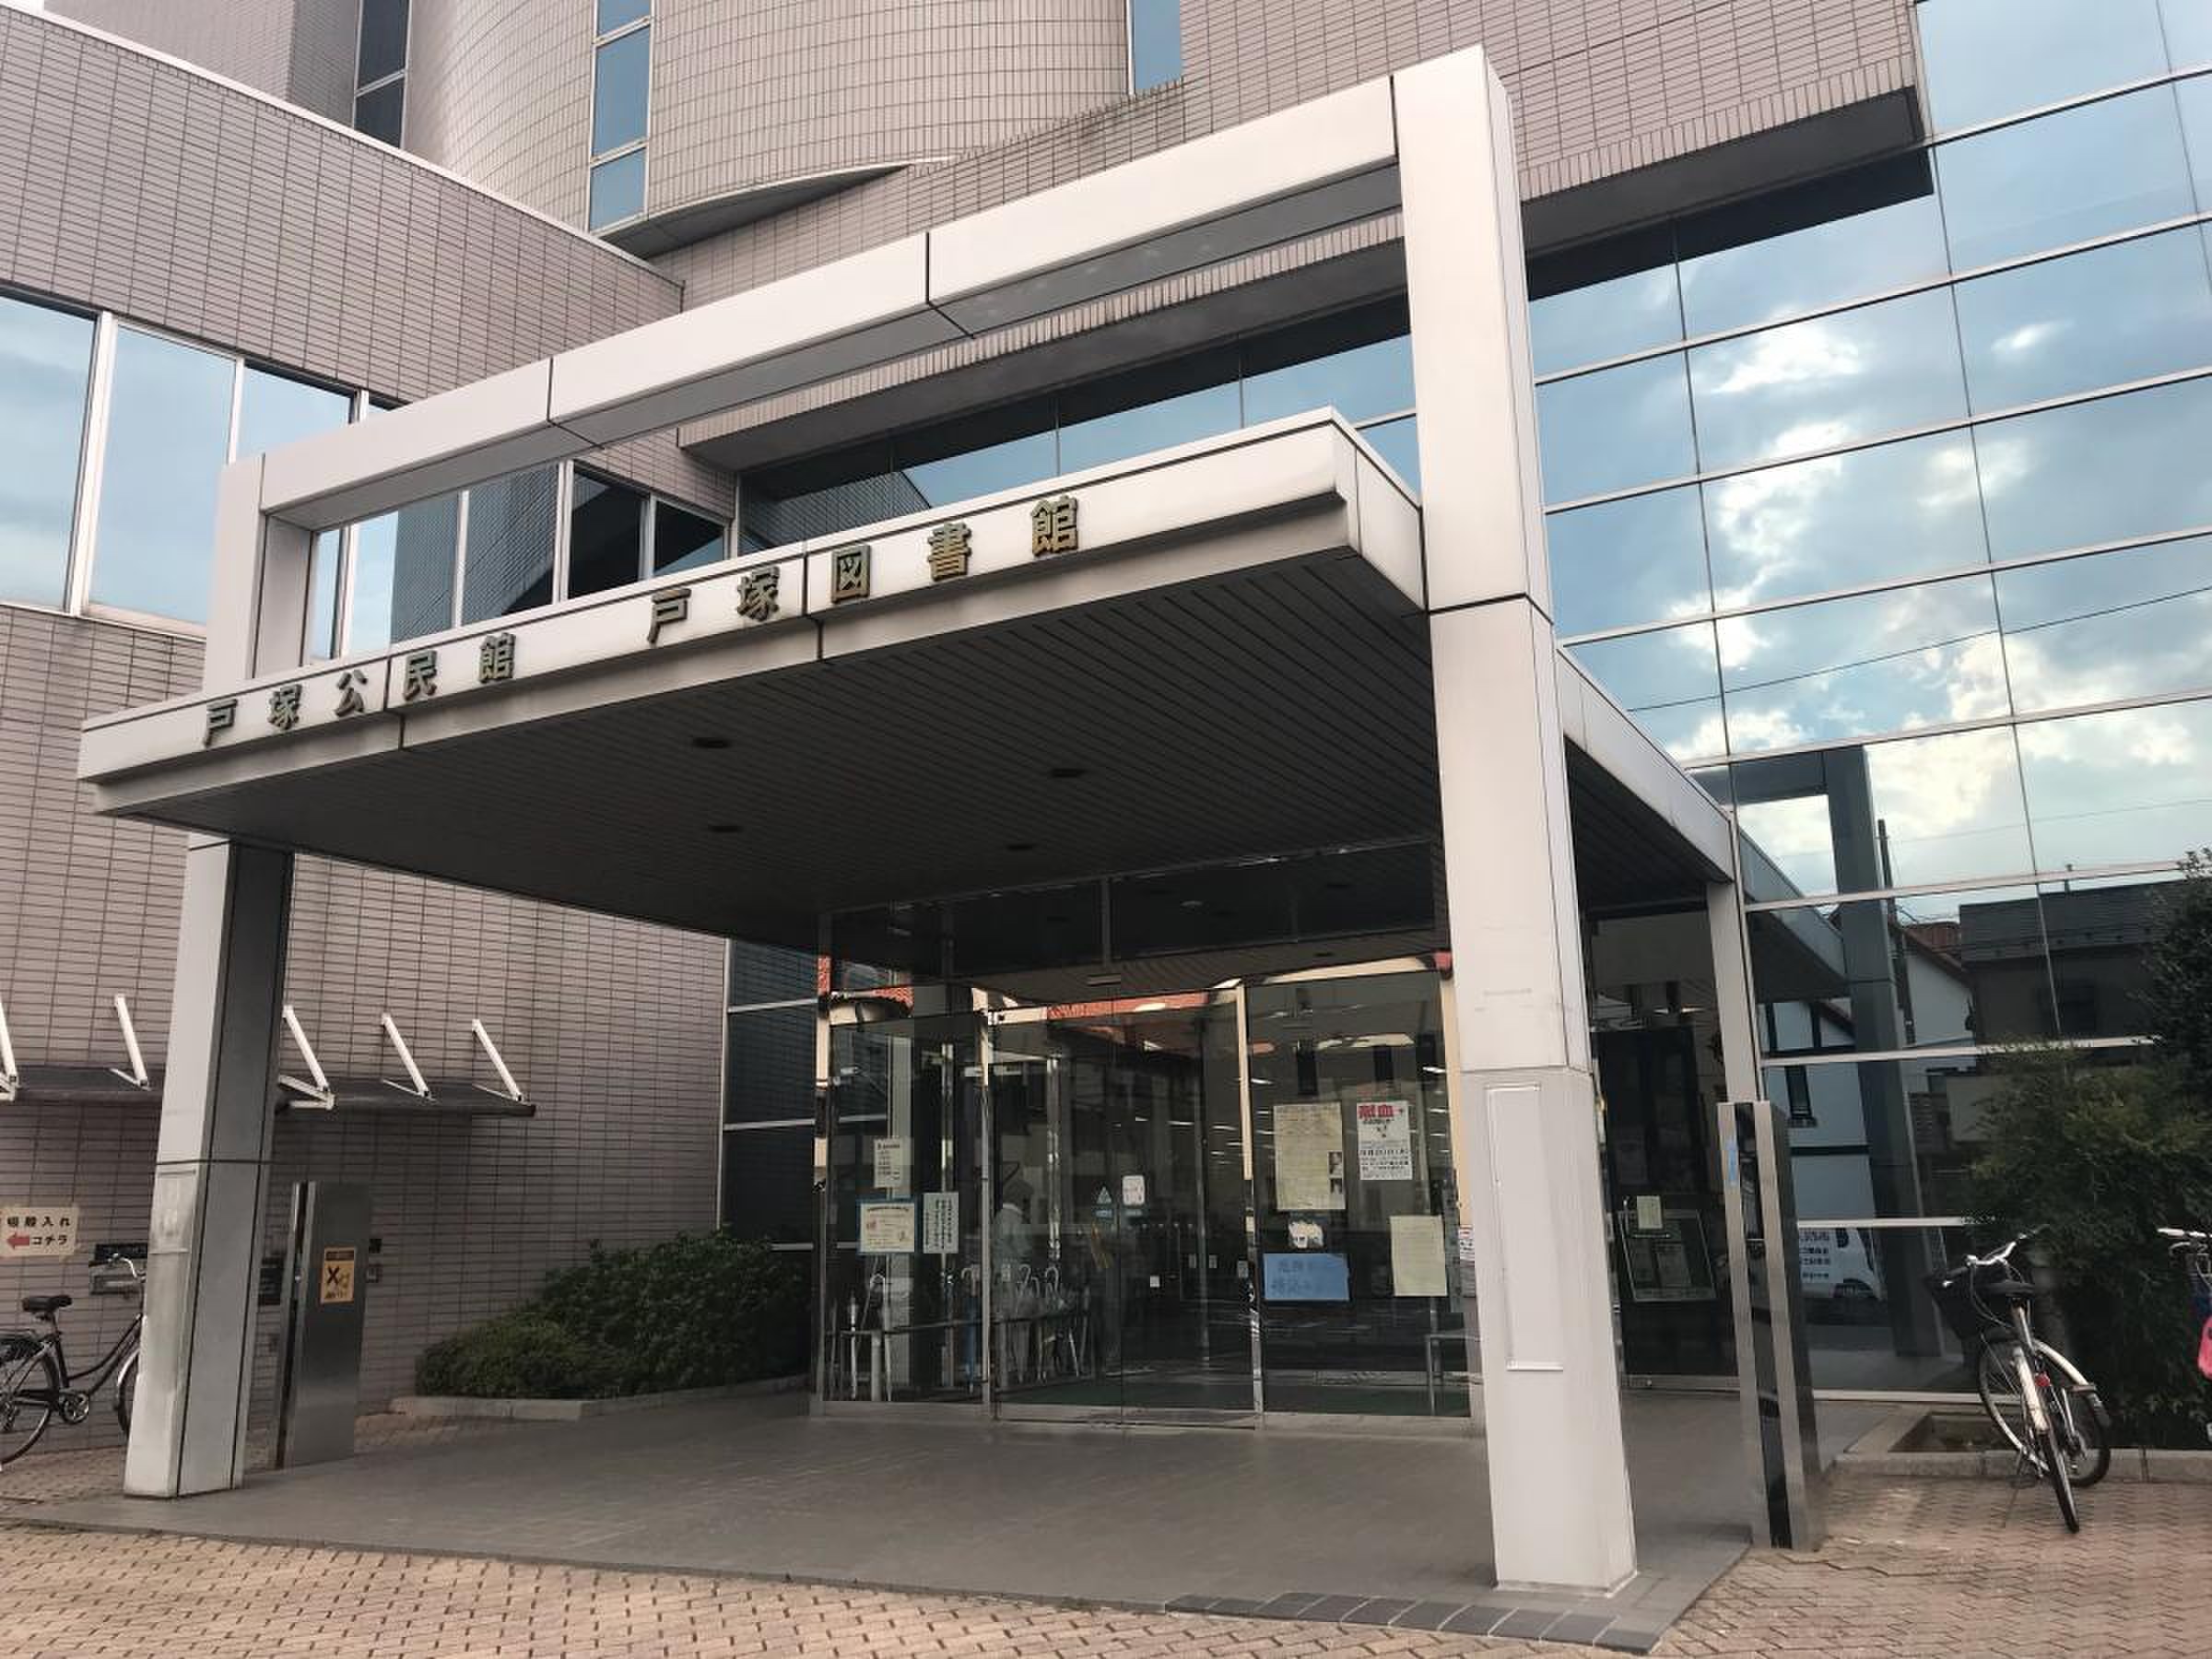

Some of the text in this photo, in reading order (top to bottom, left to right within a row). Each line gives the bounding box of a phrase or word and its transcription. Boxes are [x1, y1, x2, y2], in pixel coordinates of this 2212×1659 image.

[204, 494, 1079, 747] 戸塚公民館 戸塚図書館
[31, 1234, 67, 1245] コチラ
